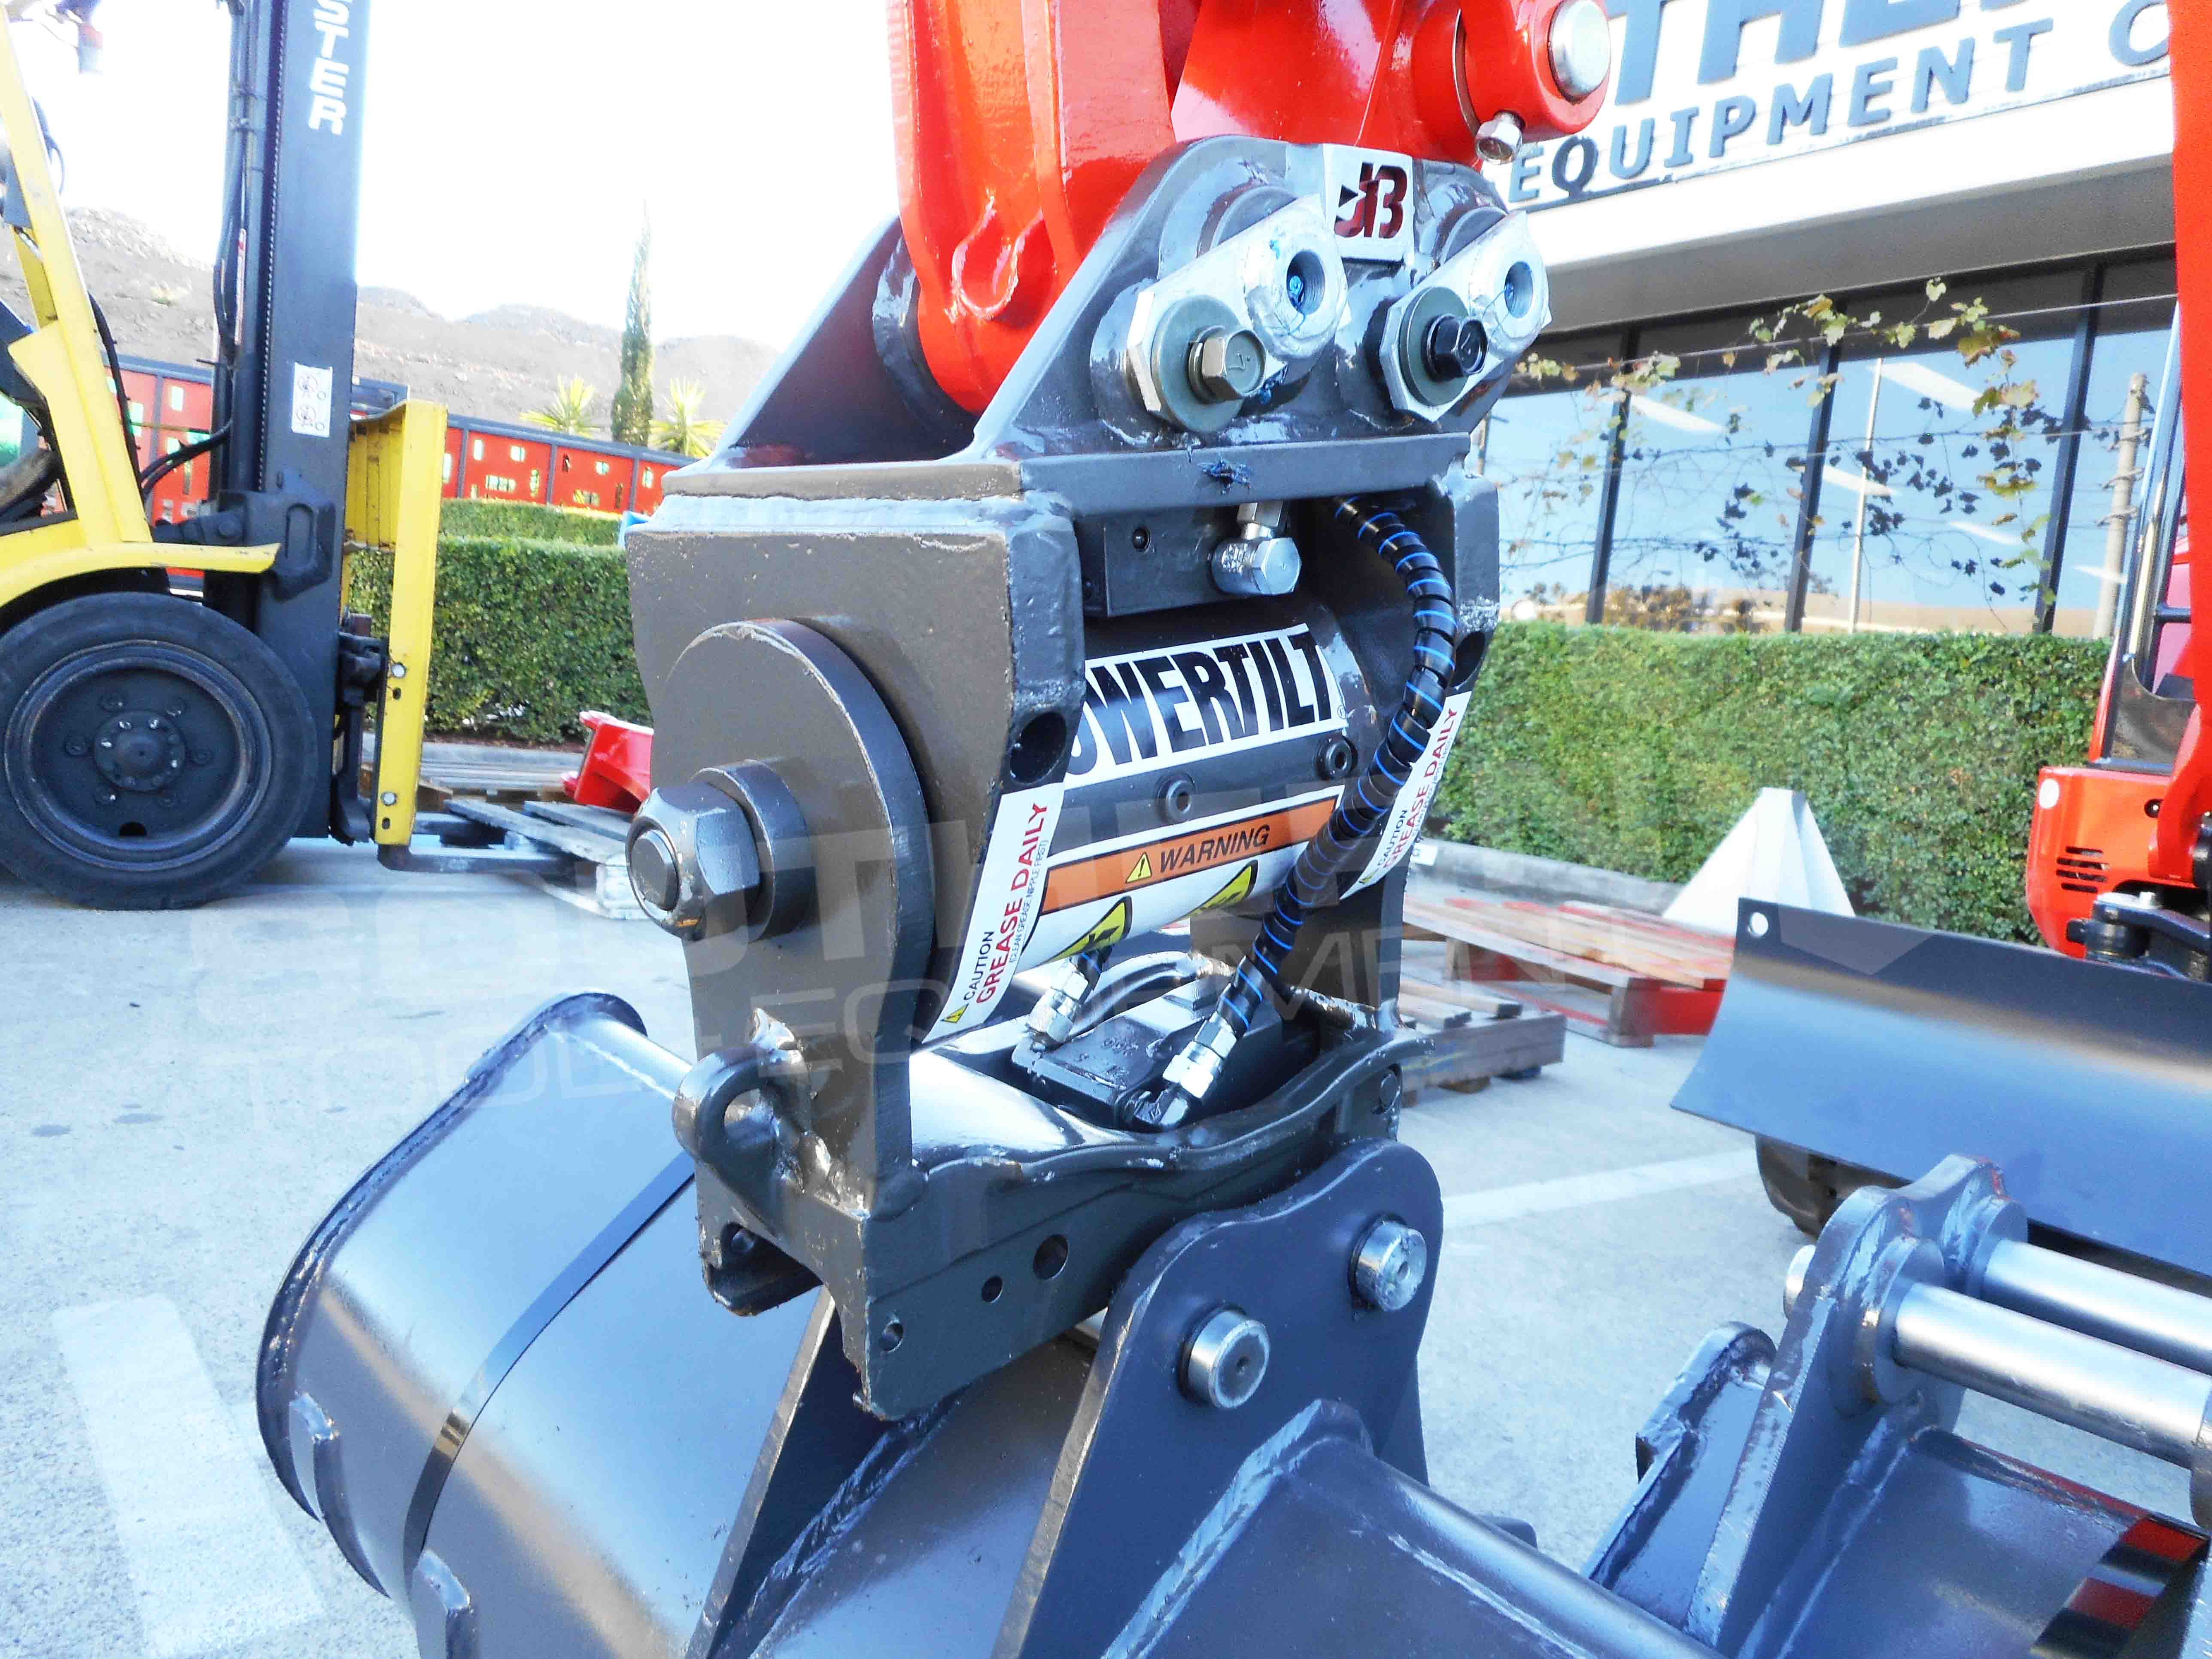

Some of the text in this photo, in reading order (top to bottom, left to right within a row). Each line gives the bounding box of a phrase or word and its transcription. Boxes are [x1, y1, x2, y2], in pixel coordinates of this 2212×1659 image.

[1508, 18, 2054, 203] EQUIPMENT
[1425, 708, 1457, 778] DAILY
[1161, 824, 1270, 873] WARNING
[976, 802, 1048, 1003] GREASE DAILY
[963, 931, 994, 1000] CAUTION
